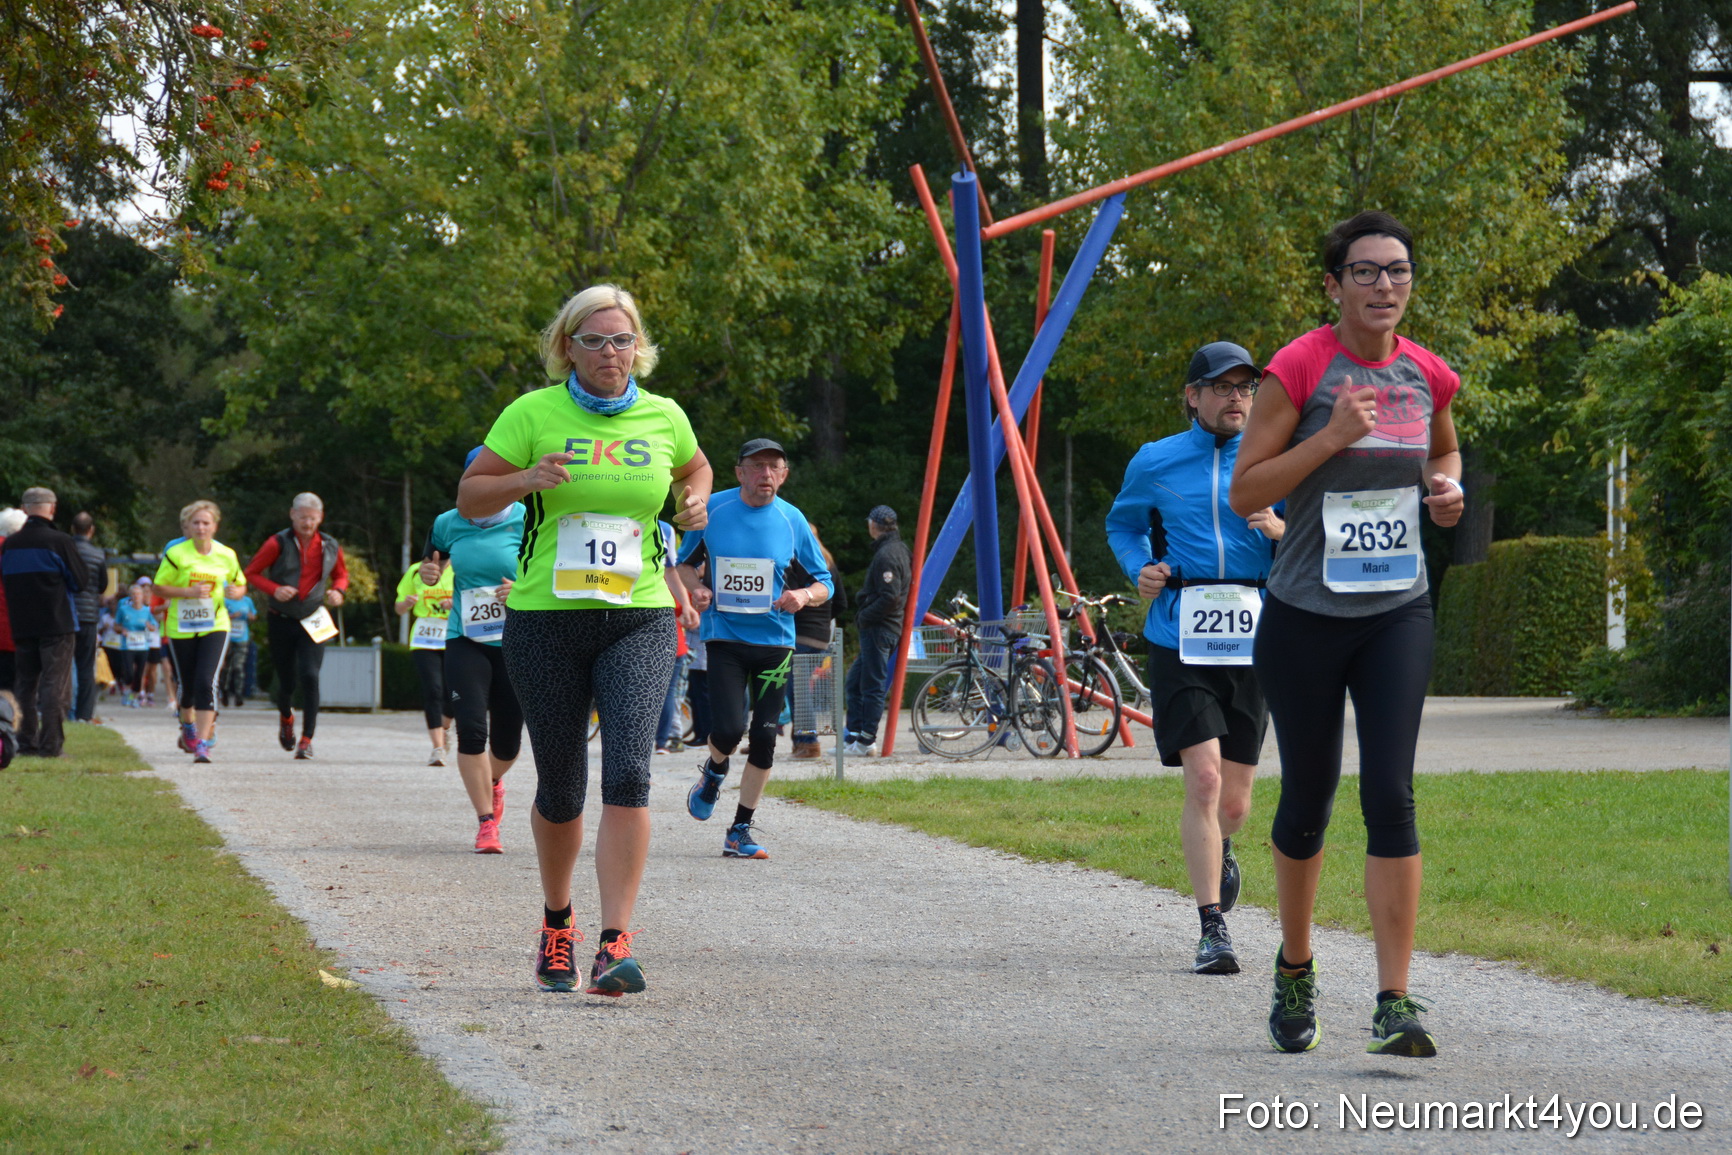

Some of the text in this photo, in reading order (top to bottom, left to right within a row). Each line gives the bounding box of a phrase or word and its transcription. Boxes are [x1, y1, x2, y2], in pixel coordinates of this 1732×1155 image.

[565, 438, 652, 467] EKS
[570, 472, 654, 482] gineering GmbH
[1340, 519, 1408, 552] 2632
[585, 538, 617, 566] 19
[1362, 562, 1390, 574] Maria
[585, 573, 610, 585] Maike
[724, 574, 764, 592] 2559
[735, 596, 751, 604] Hans
[182, 608, 209, 620] 2045
[470, 602, 505, 621] 236
[1192, 609, 1253, 633] 2219
[419, 626, 444, 638] 2417
[1206, 641, 1240, 653] Rüdiger
